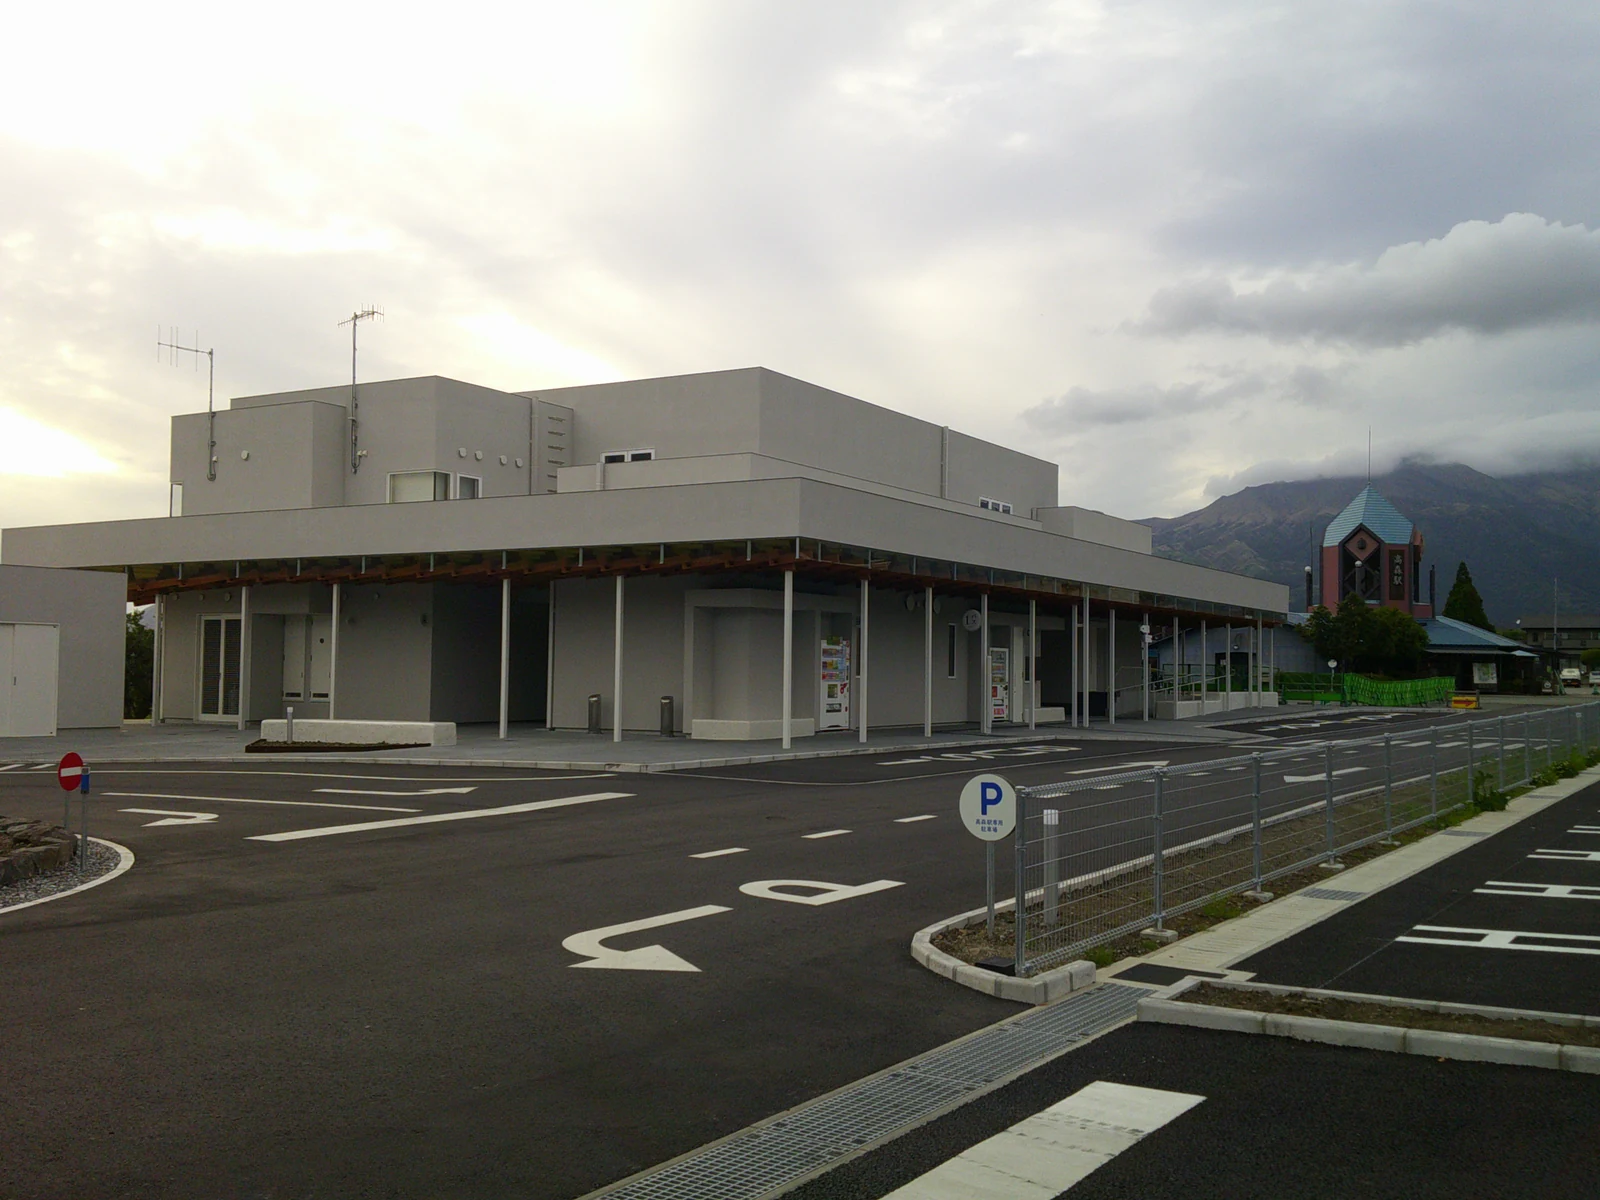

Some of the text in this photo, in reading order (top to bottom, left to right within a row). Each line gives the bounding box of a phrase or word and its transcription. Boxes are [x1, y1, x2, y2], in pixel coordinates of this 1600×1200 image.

[1393, 554, 1403, 586] 高森駅
[981, 782, 1003, 815] P
